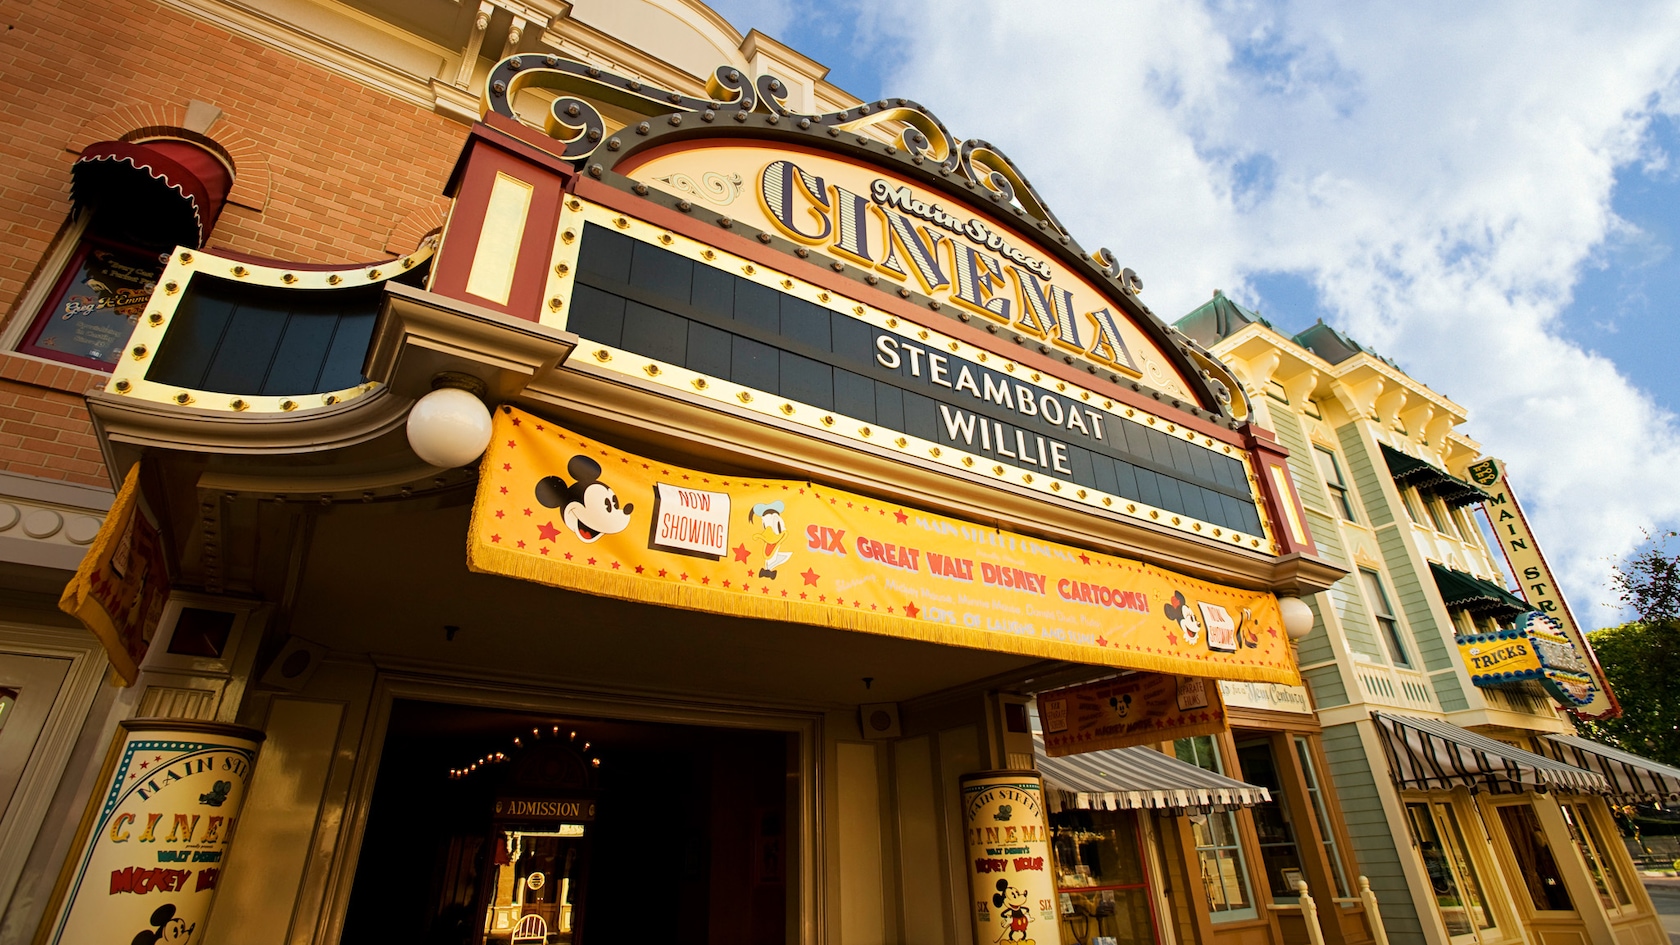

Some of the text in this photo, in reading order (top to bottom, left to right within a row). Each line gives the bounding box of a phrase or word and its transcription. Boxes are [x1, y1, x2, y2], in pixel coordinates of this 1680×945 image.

[872, 178, 1053, 281] Main Street
[757, 160, 1143, 378] CINEMA
[62, 301, 95, 320] Greg
[875, 334, 1103, 441] STEAMBOAT
[939, 404, 1072, 475] WILLIE
[678, 489, 711, 513] NOW
[661, 511, 724, 549] SHOWING
[1489, 493, 1528, 552] MAIN
[806, 524, 847, 555] SIX
[856, 536, 920, 571] GREAT
[926, 552, 975, 583] WALT
[981, 562, 1046, 597] DISNEY
[1056, 578, 1150, 613] CARTOONS!
[963, 613, 982, 629] OF
[987, 616, 1035, 636] LAUGHS
[1041, 628, 1068, 642] AND
[1068, 629, 1096, 646] FUN!
[1471, 644, 1527, 670] TRICKS
[1270, 683, 1306, 712] Century
[135, 757, 214, 803] MAIN
[506, 800, 580, 817] ADMISSION
[157, 850, 192, 863] WALT
[975, 856, 1044, 874] MICKEY MOUSE
[109, 866, 192, 895] MICKEY
[977, 901, 990, 913] SIX
[1039, 899, 1053, 911] SIX
